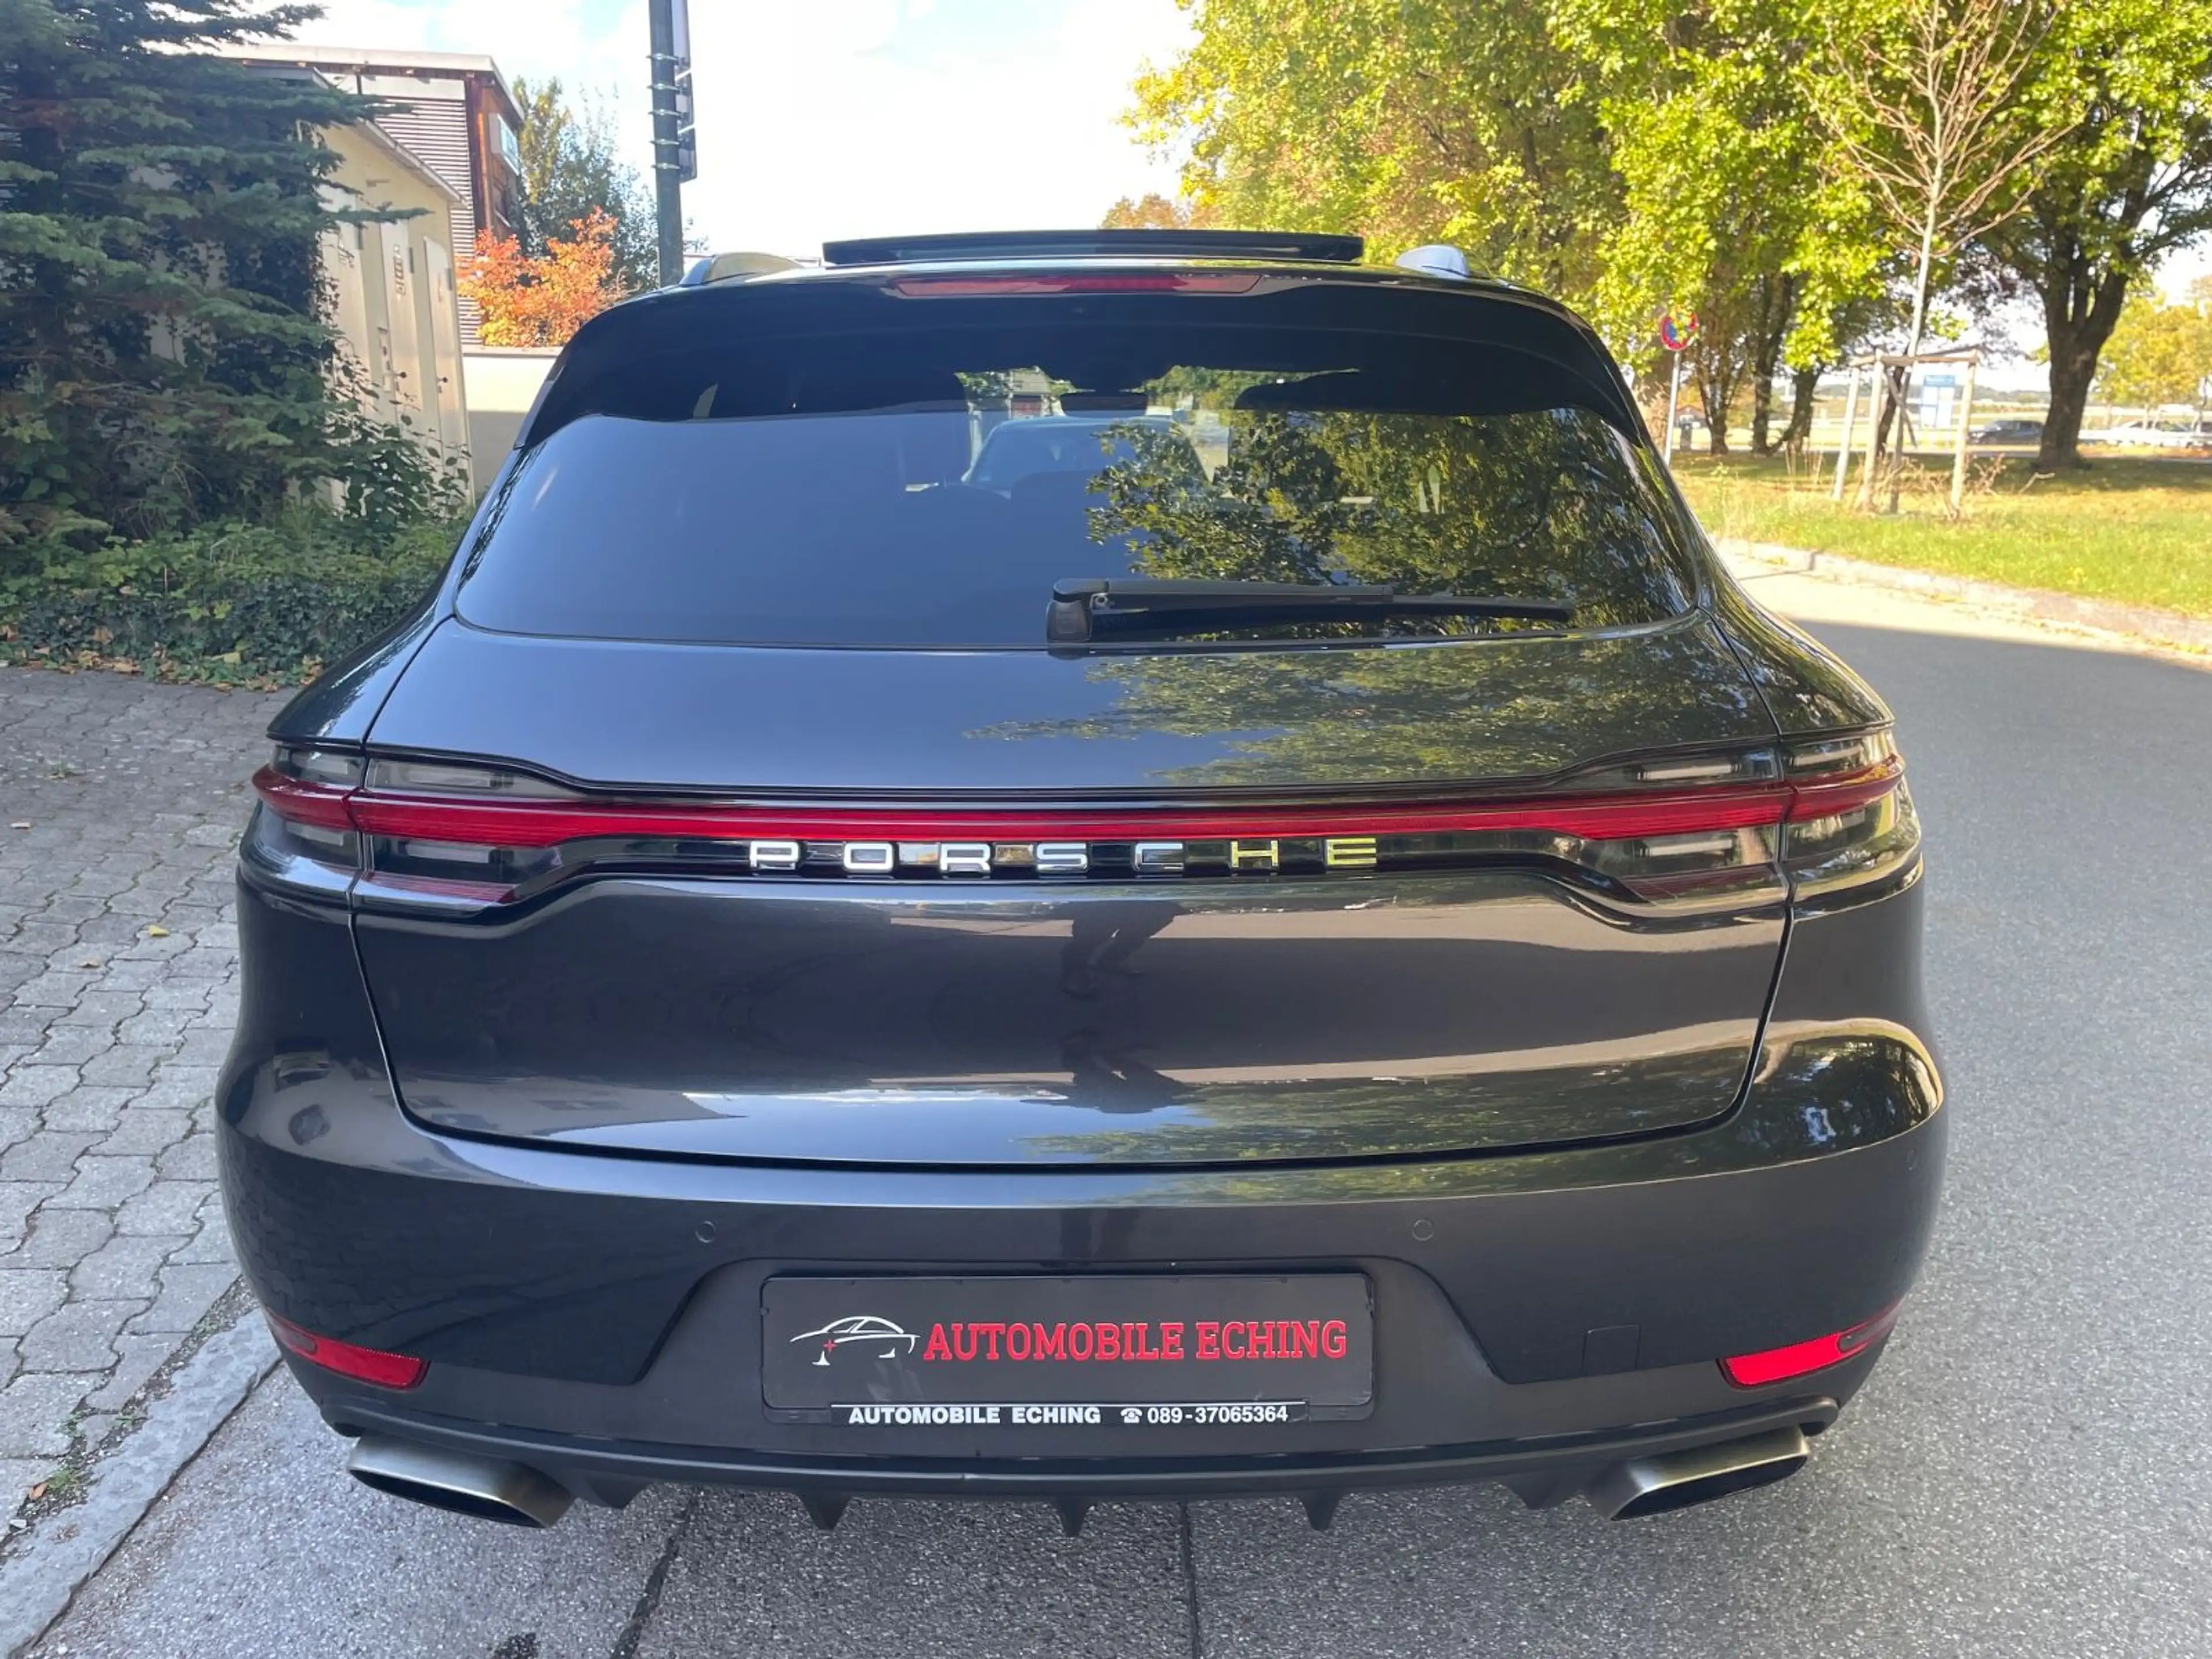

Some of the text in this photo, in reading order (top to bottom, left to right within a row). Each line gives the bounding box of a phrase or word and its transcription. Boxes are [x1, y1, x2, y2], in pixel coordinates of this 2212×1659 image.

[749, 837, 1377, 873] PORSCHE
[923, 1320, 1347, 1361] AUTOMOBILE ECHING
[849, 1407, 1001, 1424] AUTOMOBILE
[1012, 1407, 1101, 1424] ECHING
